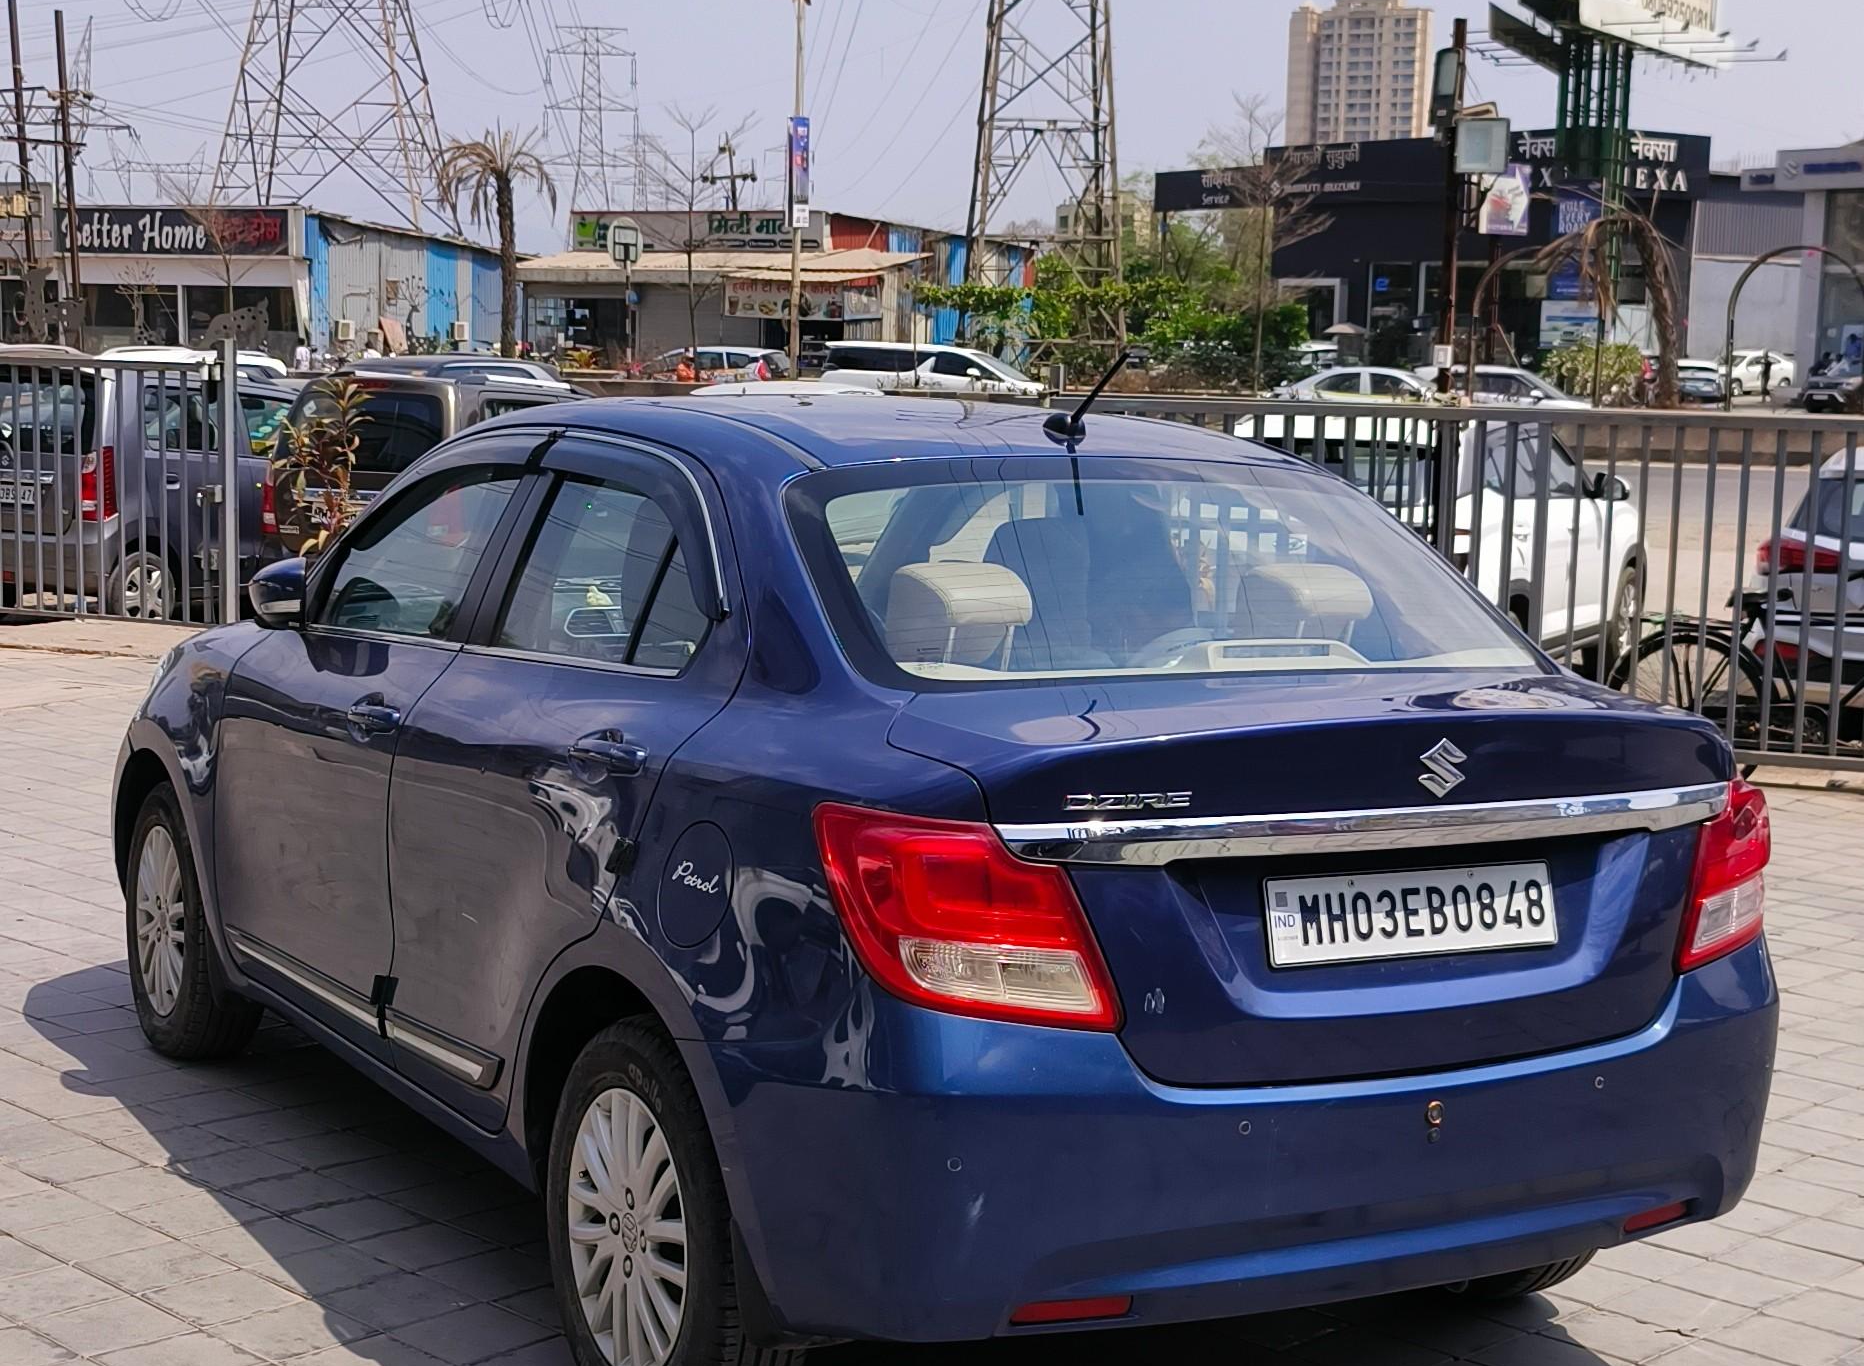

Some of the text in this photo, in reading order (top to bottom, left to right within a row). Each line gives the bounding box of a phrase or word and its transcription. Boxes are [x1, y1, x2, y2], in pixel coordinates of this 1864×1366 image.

[1201, 193, 1230, 206] Service
[138, 211, 207, 251] Home
[1063, 791, 1193, 811] DZIRE
[671, 860, 720, 894] Petrol
[1273, 878, 1546, 947] IND MH03EB0848
